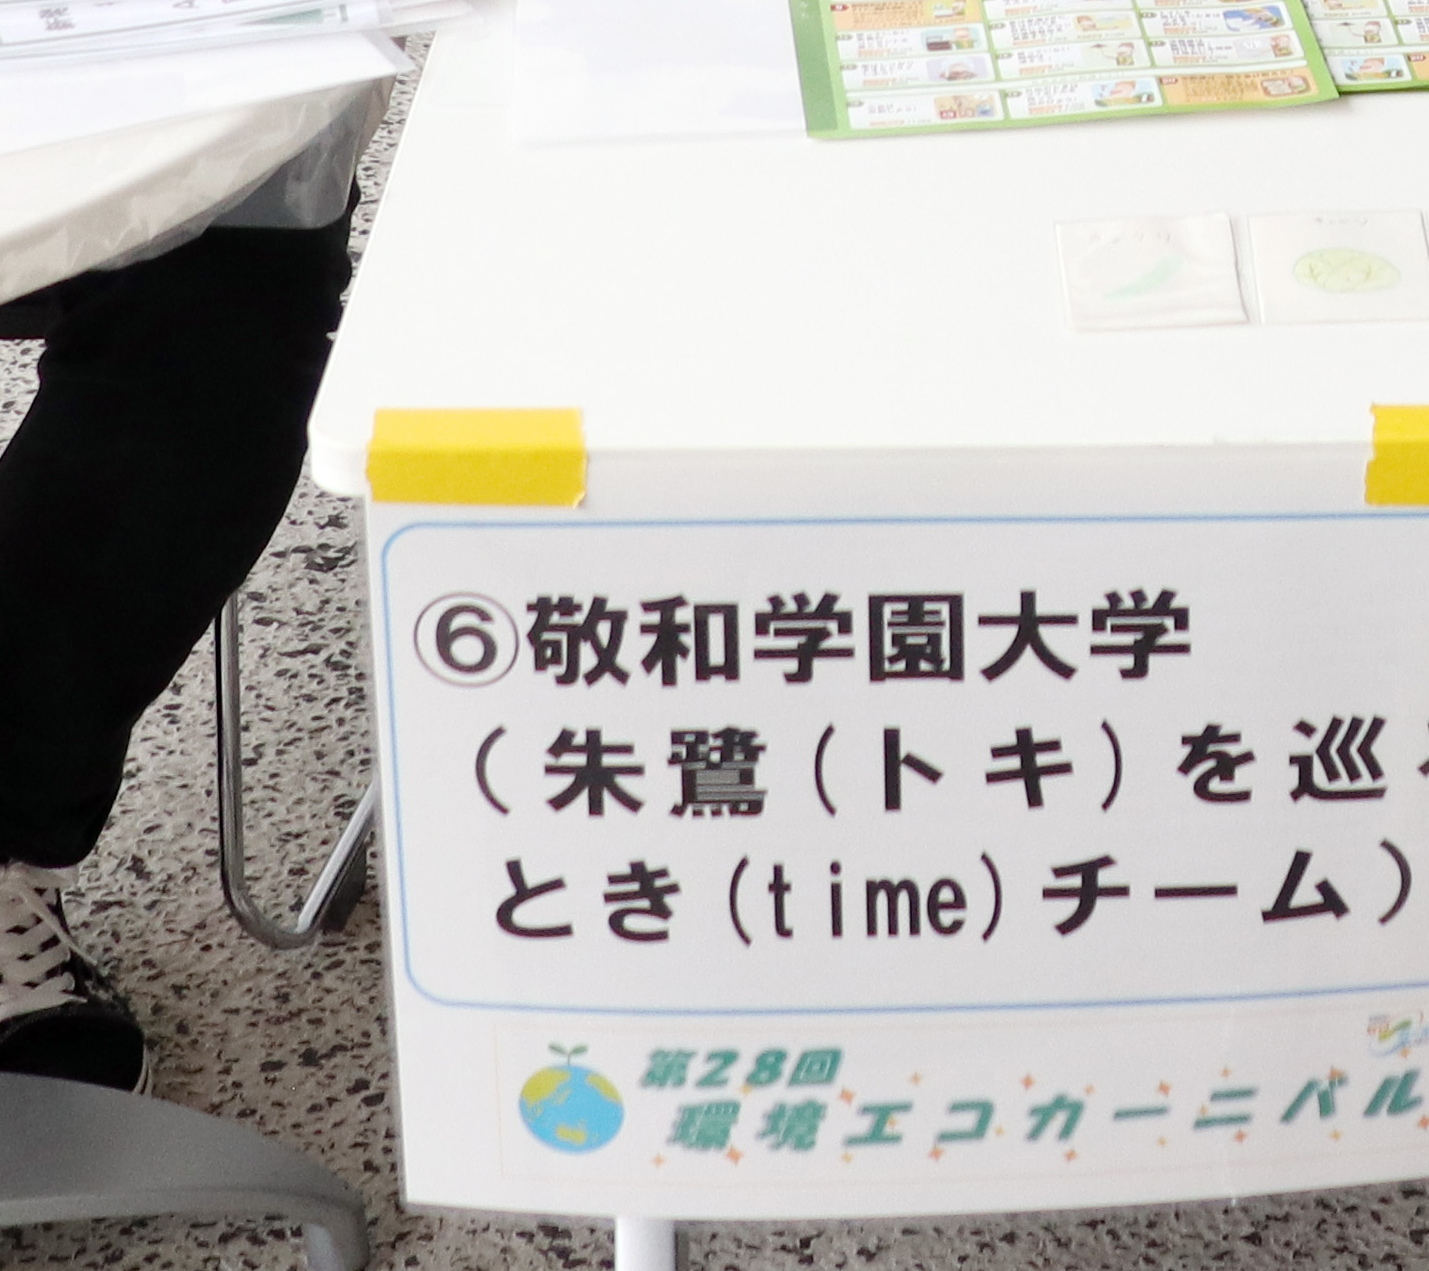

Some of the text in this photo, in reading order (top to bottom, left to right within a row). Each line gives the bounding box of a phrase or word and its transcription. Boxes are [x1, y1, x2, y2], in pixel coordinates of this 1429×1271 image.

[413, 589, 1192, 687] ⑥敬和学園大学
[640, 1047, 843, 1090] 第28回
[667, 1069, 1426, 1154] 環境エコカーニバル
